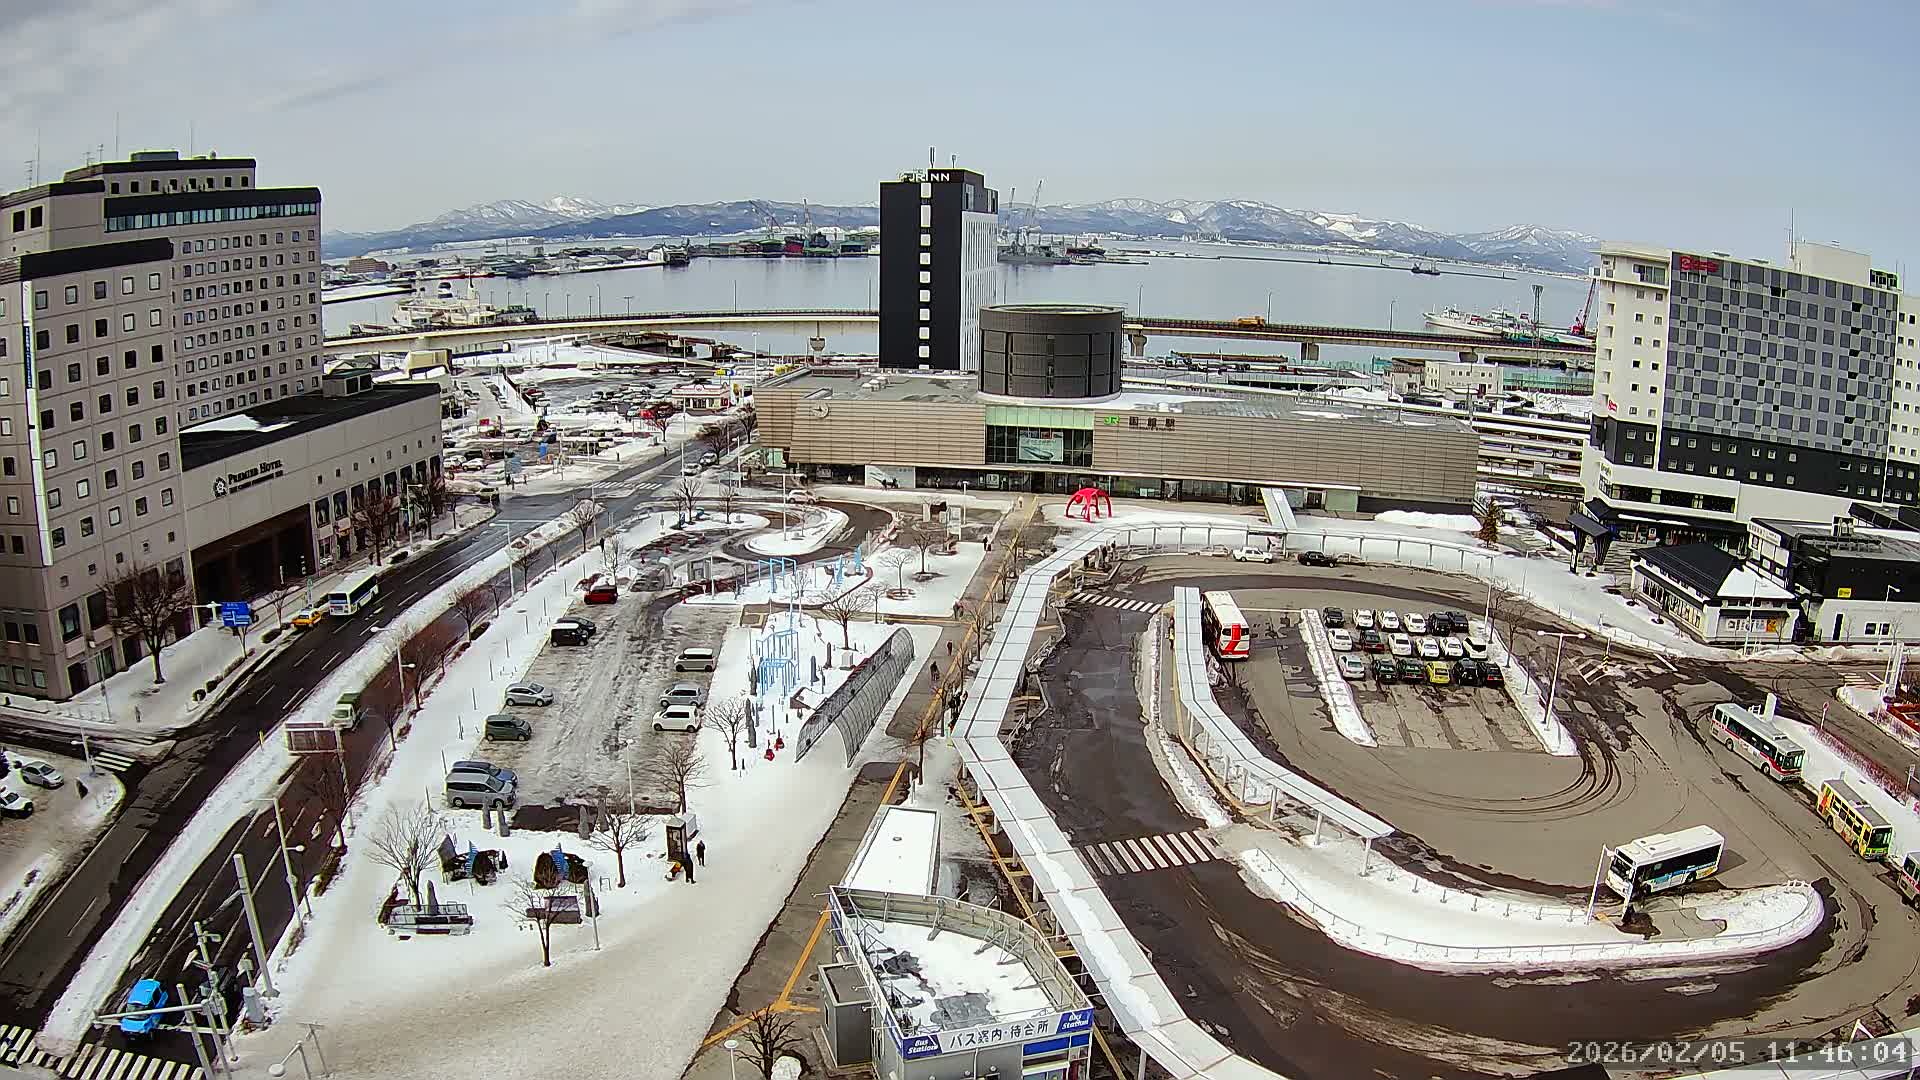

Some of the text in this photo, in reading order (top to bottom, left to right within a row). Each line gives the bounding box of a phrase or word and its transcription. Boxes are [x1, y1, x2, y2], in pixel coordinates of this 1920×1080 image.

[926, 172, 950, 182] INN
[1104, 415, 1120, 425] JR
[914, 1039, 929, 1047] Bus
[908, 1044, 939, 1054] Station
